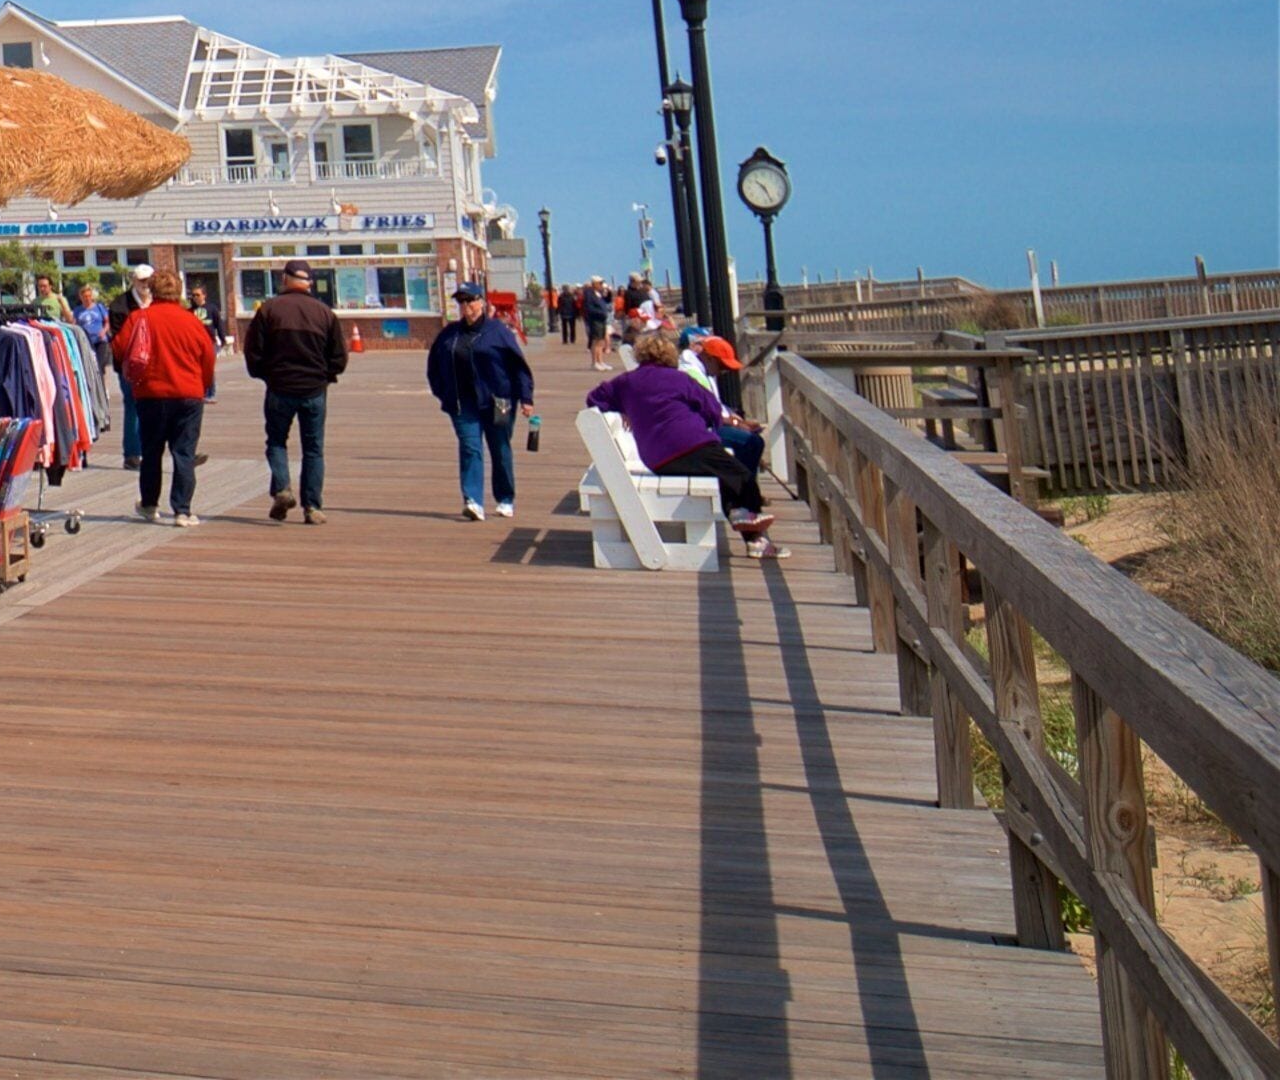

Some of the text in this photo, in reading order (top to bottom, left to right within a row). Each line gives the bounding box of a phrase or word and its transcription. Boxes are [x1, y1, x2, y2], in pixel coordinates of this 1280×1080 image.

[25, 222, 88, 235] CUSTARD
[193, 214, 427, 232] BOARDWALK FRIES
